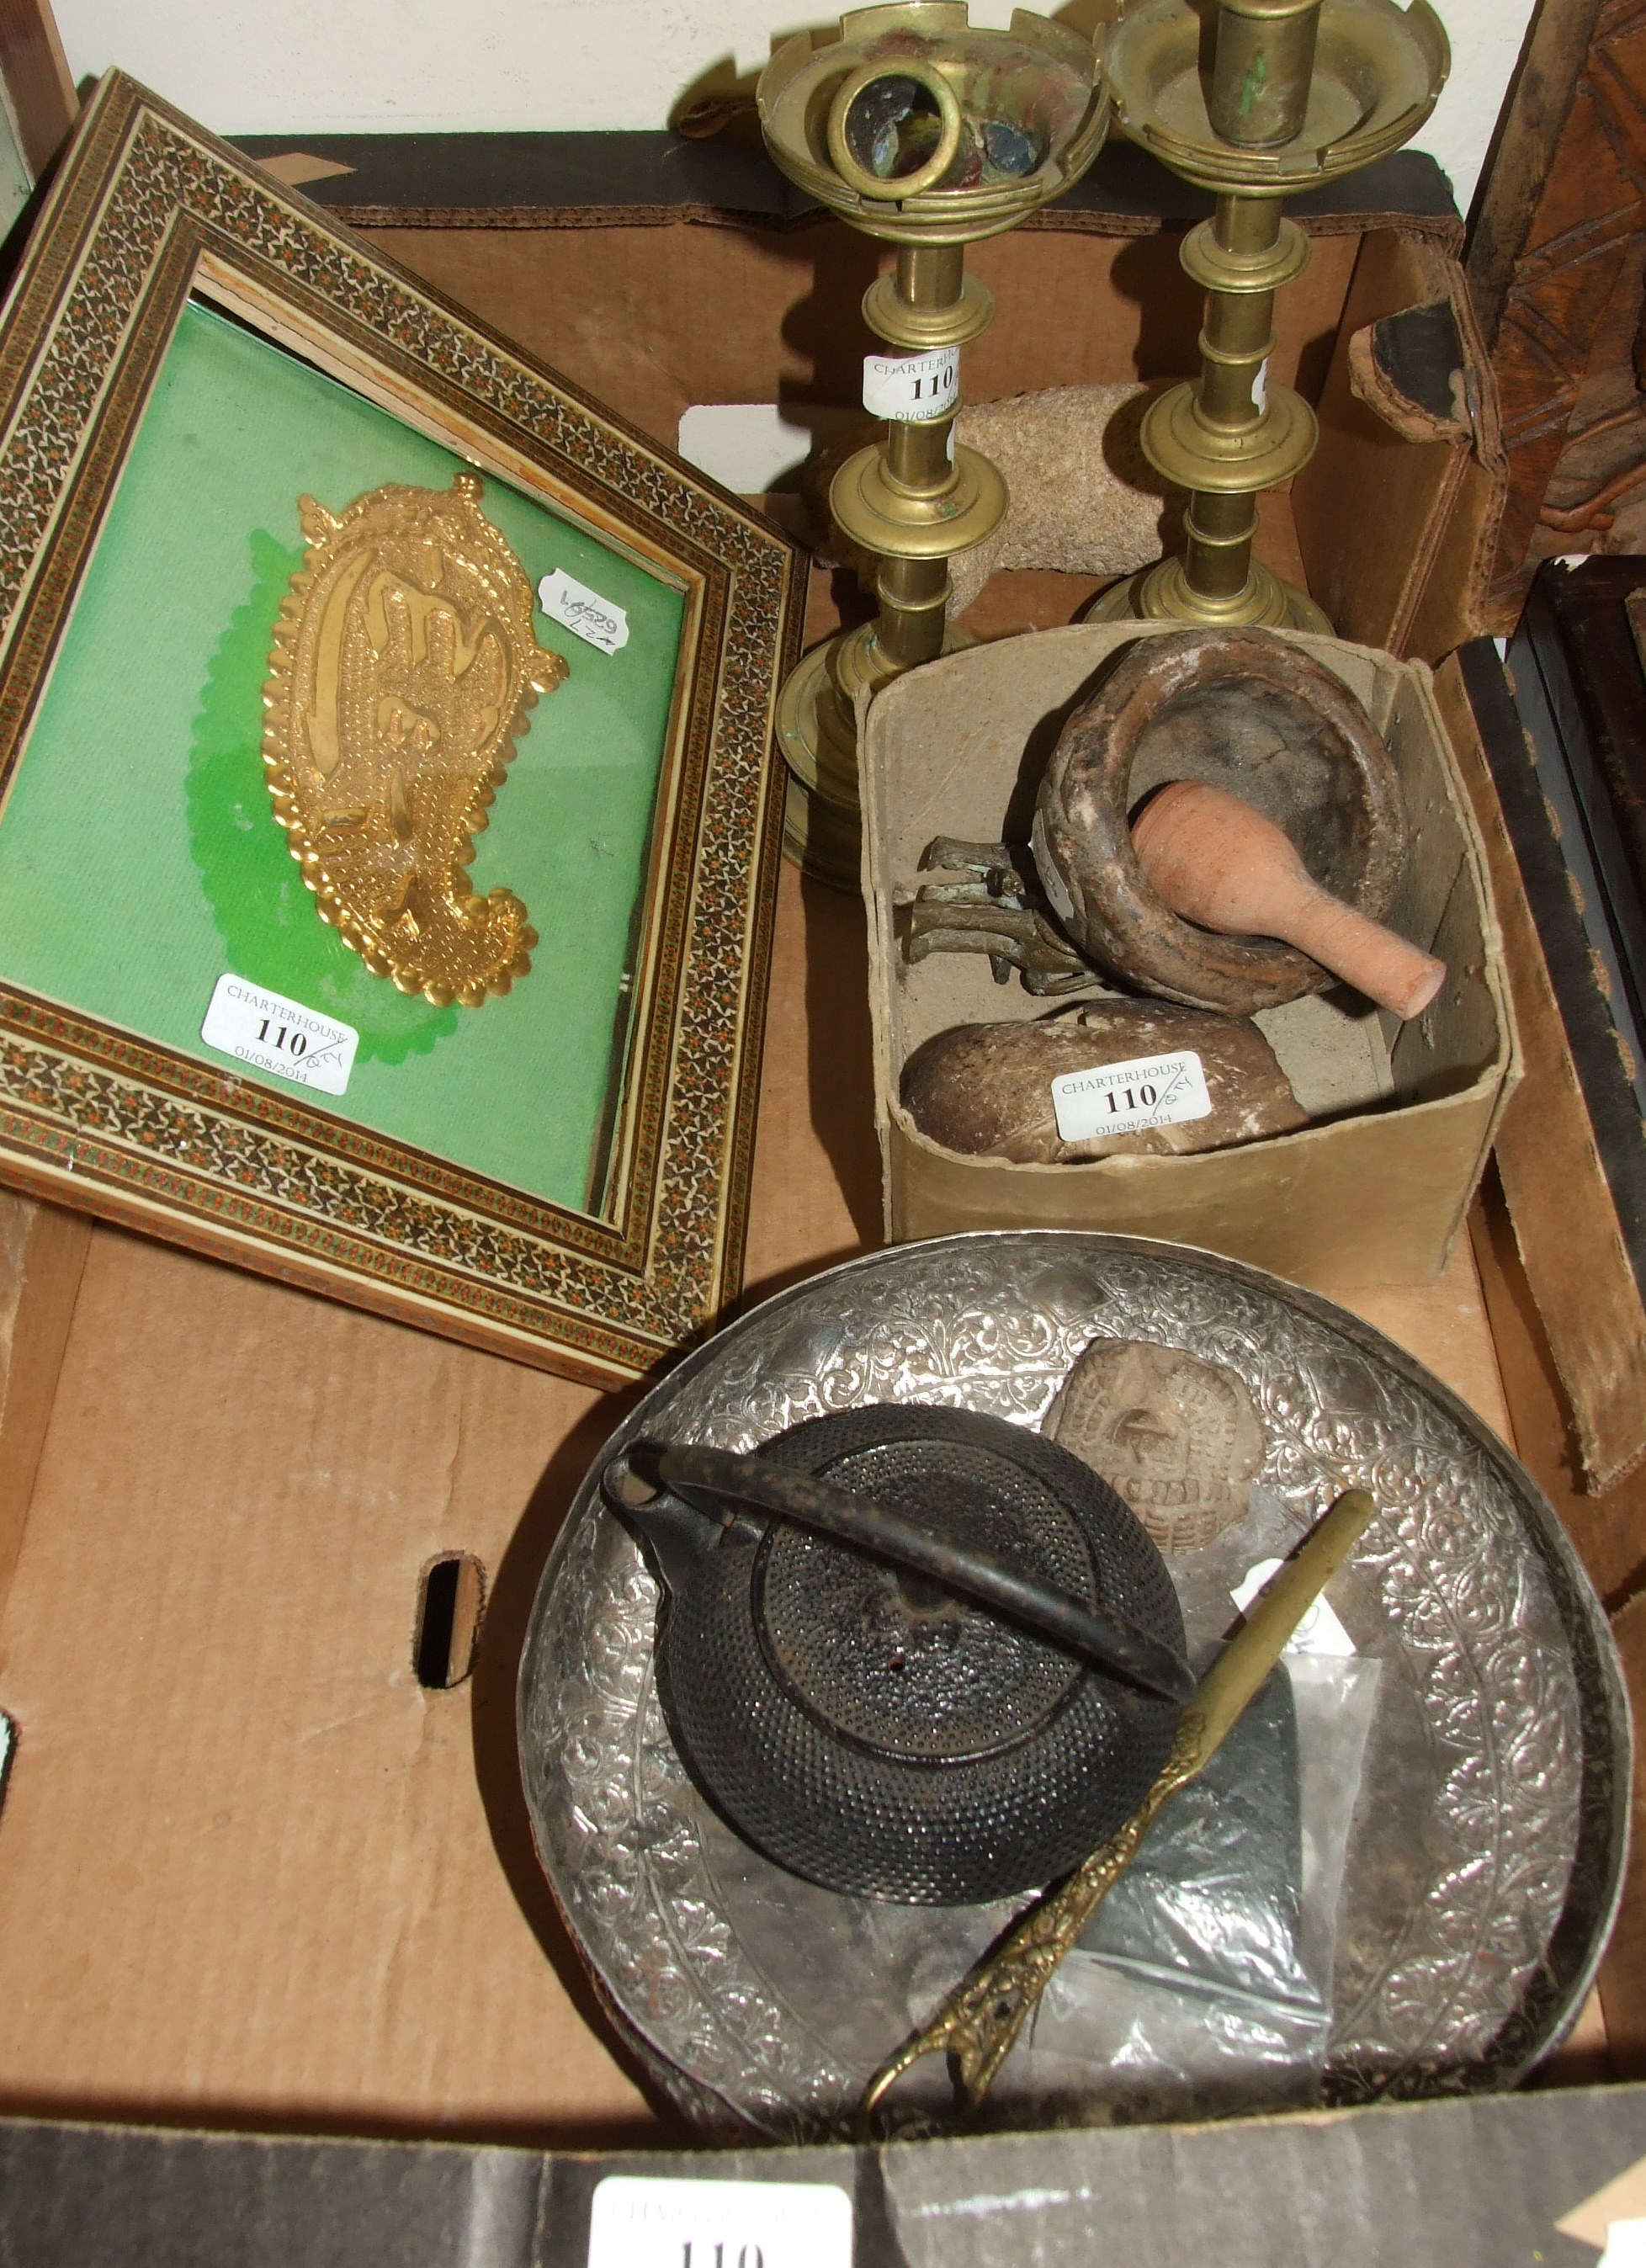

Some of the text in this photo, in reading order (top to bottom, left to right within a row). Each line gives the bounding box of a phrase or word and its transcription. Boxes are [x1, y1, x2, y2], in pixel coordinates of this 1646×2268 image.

[910, 365, 953, 401] 110
[226, 985, 347, 1044] CHARTERHOUSE
[255, 1018, 307, 1056] 110
[234, 1045, 309, 1083] 01/08/2014
[1061, 1061, 1187, 1095] CHARTERHOUSE
[1103, 1084, 1157, 1114] 110
[1096, 1113, 1173, 1135] 01/08/2014
